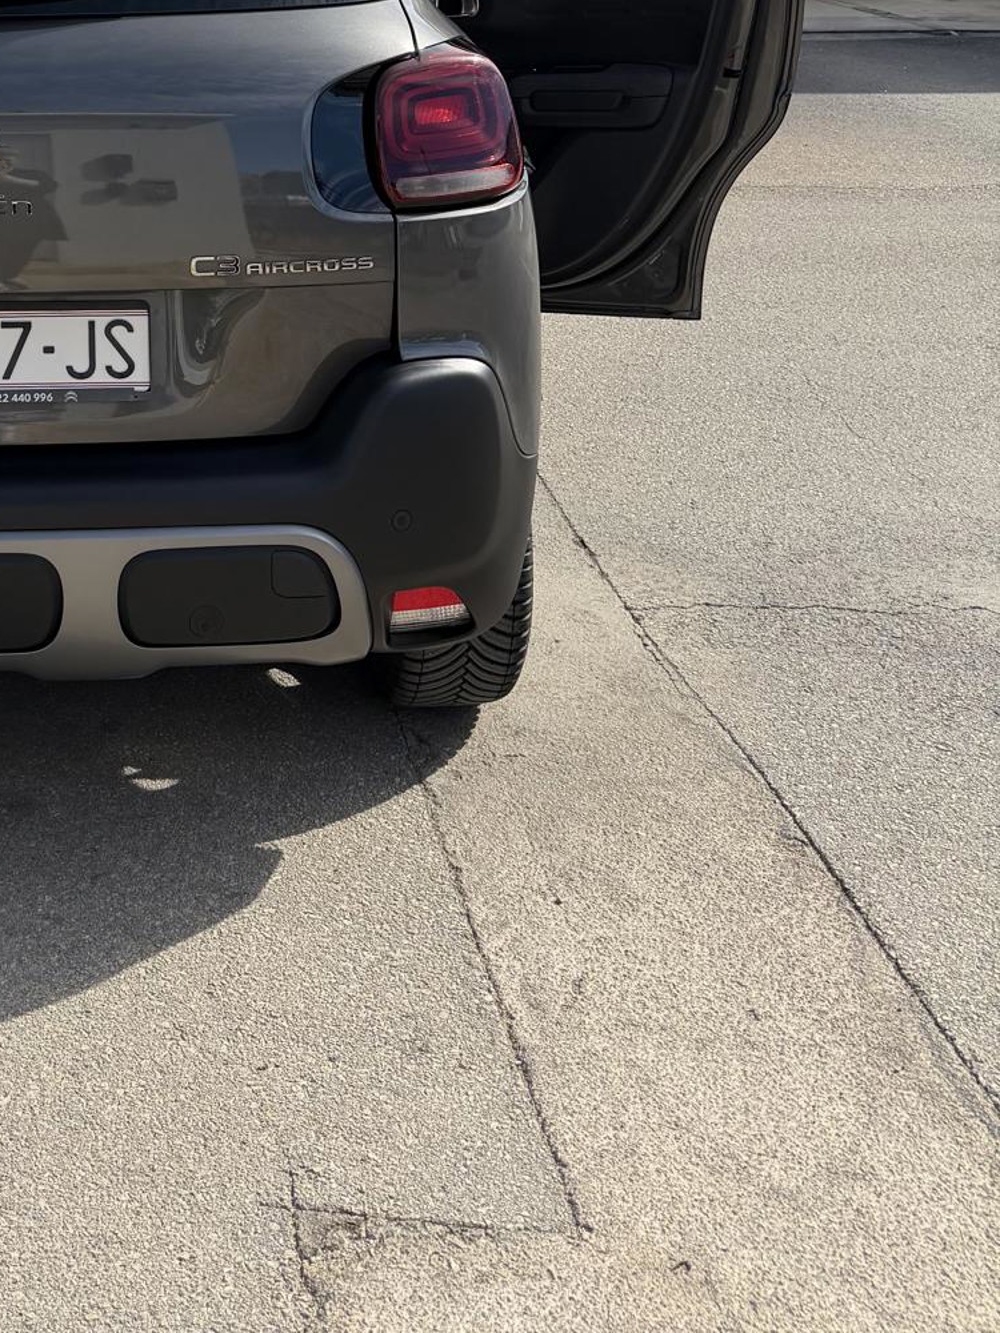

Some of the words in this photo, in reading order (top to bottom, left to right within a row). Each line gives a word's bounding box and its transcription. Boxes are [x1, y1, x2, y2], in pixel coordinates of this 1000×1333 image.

[190, 256, 241, 277] C3
[246, 257, 374, 275] AIRCROSS
[11, 393, 31, 403] 440
[33, 392, 53, 402] 996
